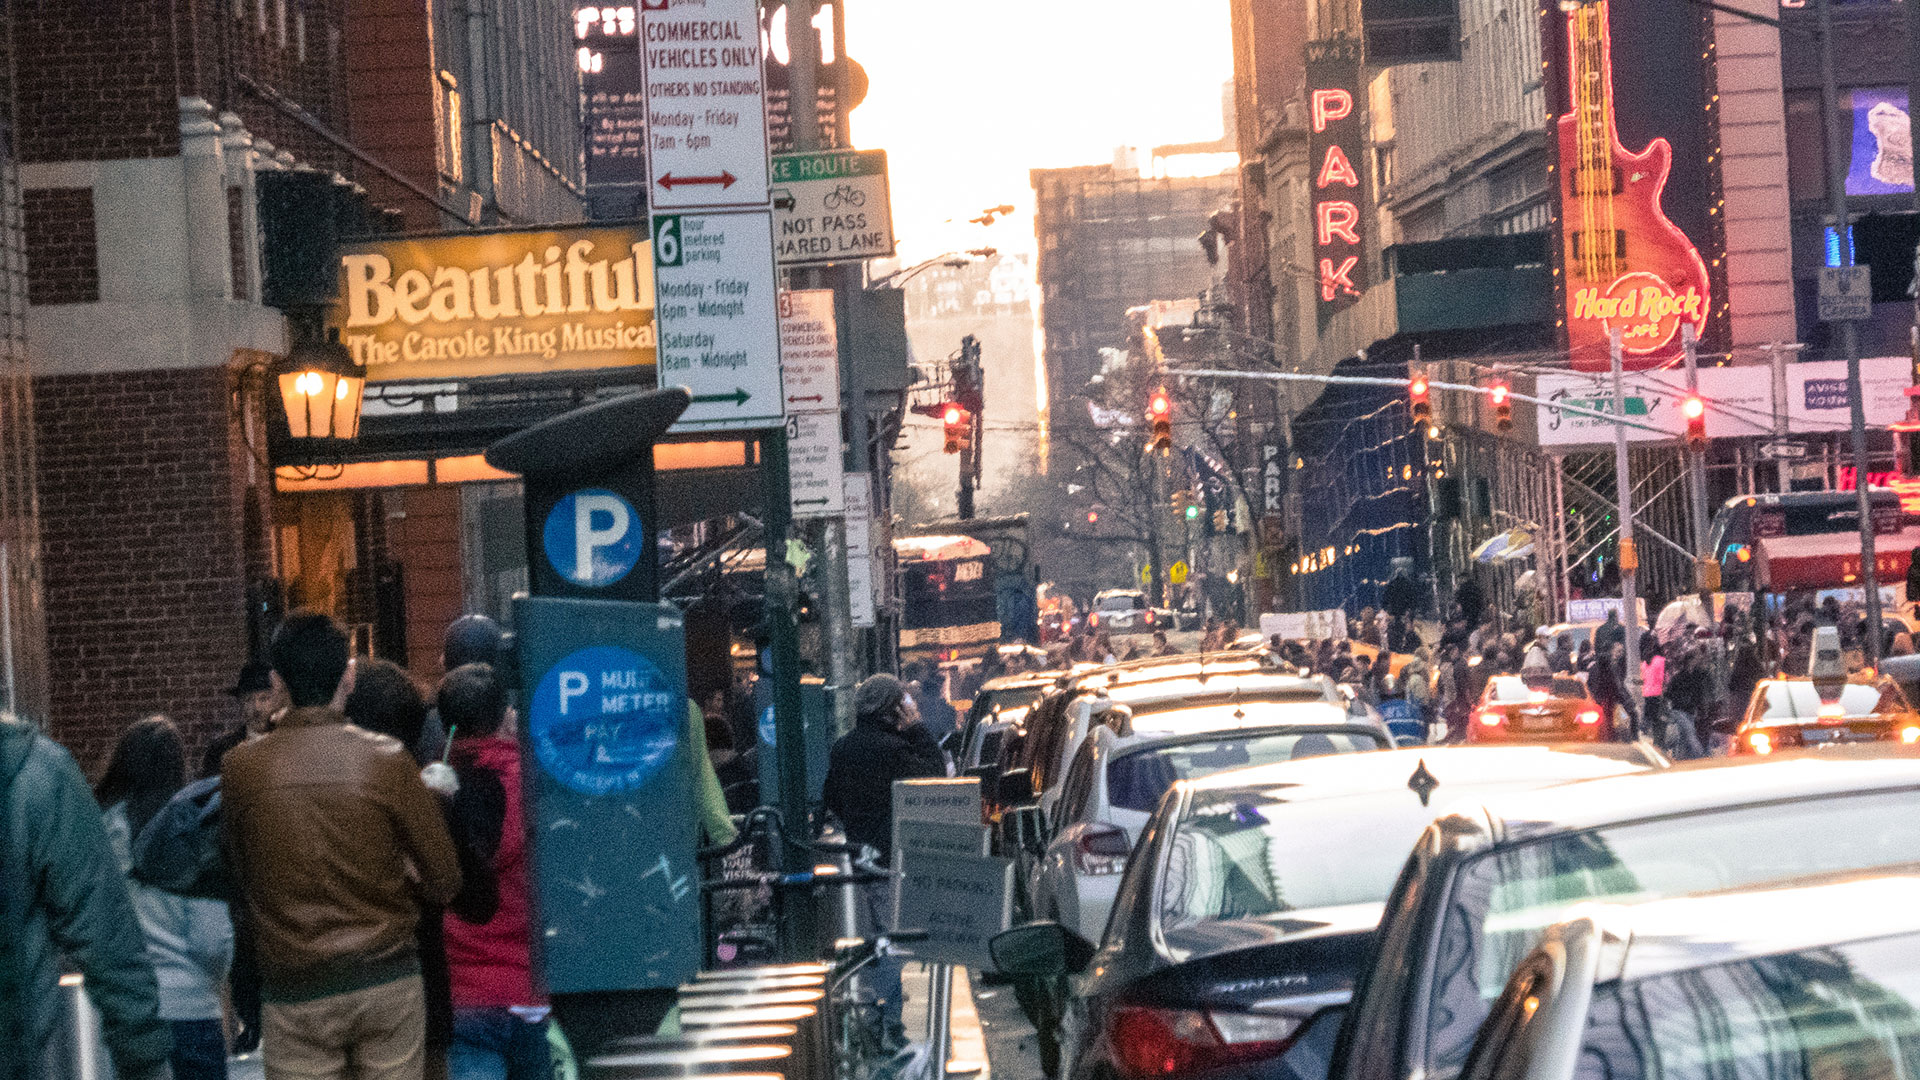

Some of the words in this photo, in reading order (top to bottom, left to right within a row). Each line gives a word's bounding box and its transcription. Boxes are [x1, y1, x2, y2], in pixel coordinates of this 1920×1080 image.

[647, 21, 742, 41] COMMERCIAL
[649, 48, 717, 69] VEHICLES
[722, 47, 757, 67] ONLY
[650, 82, 690, 97] OTHERS
[693, 82, 708, 96] NO
[710, 80, 759, 96] STANDING
[651, 110, 694, 128] Monday
[705, 108, 739, 128] Friday
[652, 133, 676, 150] 7am
[686, 133, 711, 150] 6pm
[772, 160, 791, 178] KE
[800, 156, 860, 176] ROUTE
[1311, 88, 1361, 302] PARK
[783, 217, 815, 235] NOT
[822, 213, 867, 232] PASS
[657, 218, 679, 264] 6
[684, 219, 704, 231] hour
[684, 232, 725, 246] metered
[776, 237, 831, 256] HARED
[840, 232, 885, 251] LANE
[685, 248, 721, 263] parking
[342, 239, 655, 325] Beautiful
[661, 281, 704, 299] Monday
[715, 279, 749, 297] Friday
[662, 305, 687, 320] 6pm
[698, 301, 745, 319] Midnight
[1574, 287, 1638, 319] Hard
[1639, 286, 1702, 323] Rock
[347, 334, 399, 366] The
[402, 331, 490, 362] Carole
[493, 325, 556, 359] King
[562, 318, 656, 352] Musical
[664, 333, 715, 349] Saturday
[665, 355, 690, 370] 8am
[701, 351, 748, 370] Midnight
[1263, 445, 1281, 510] PARK
[574, 494, 629, 580] P
[558, 671, 589, 715] P
[602, 693, 670, 714] METER
